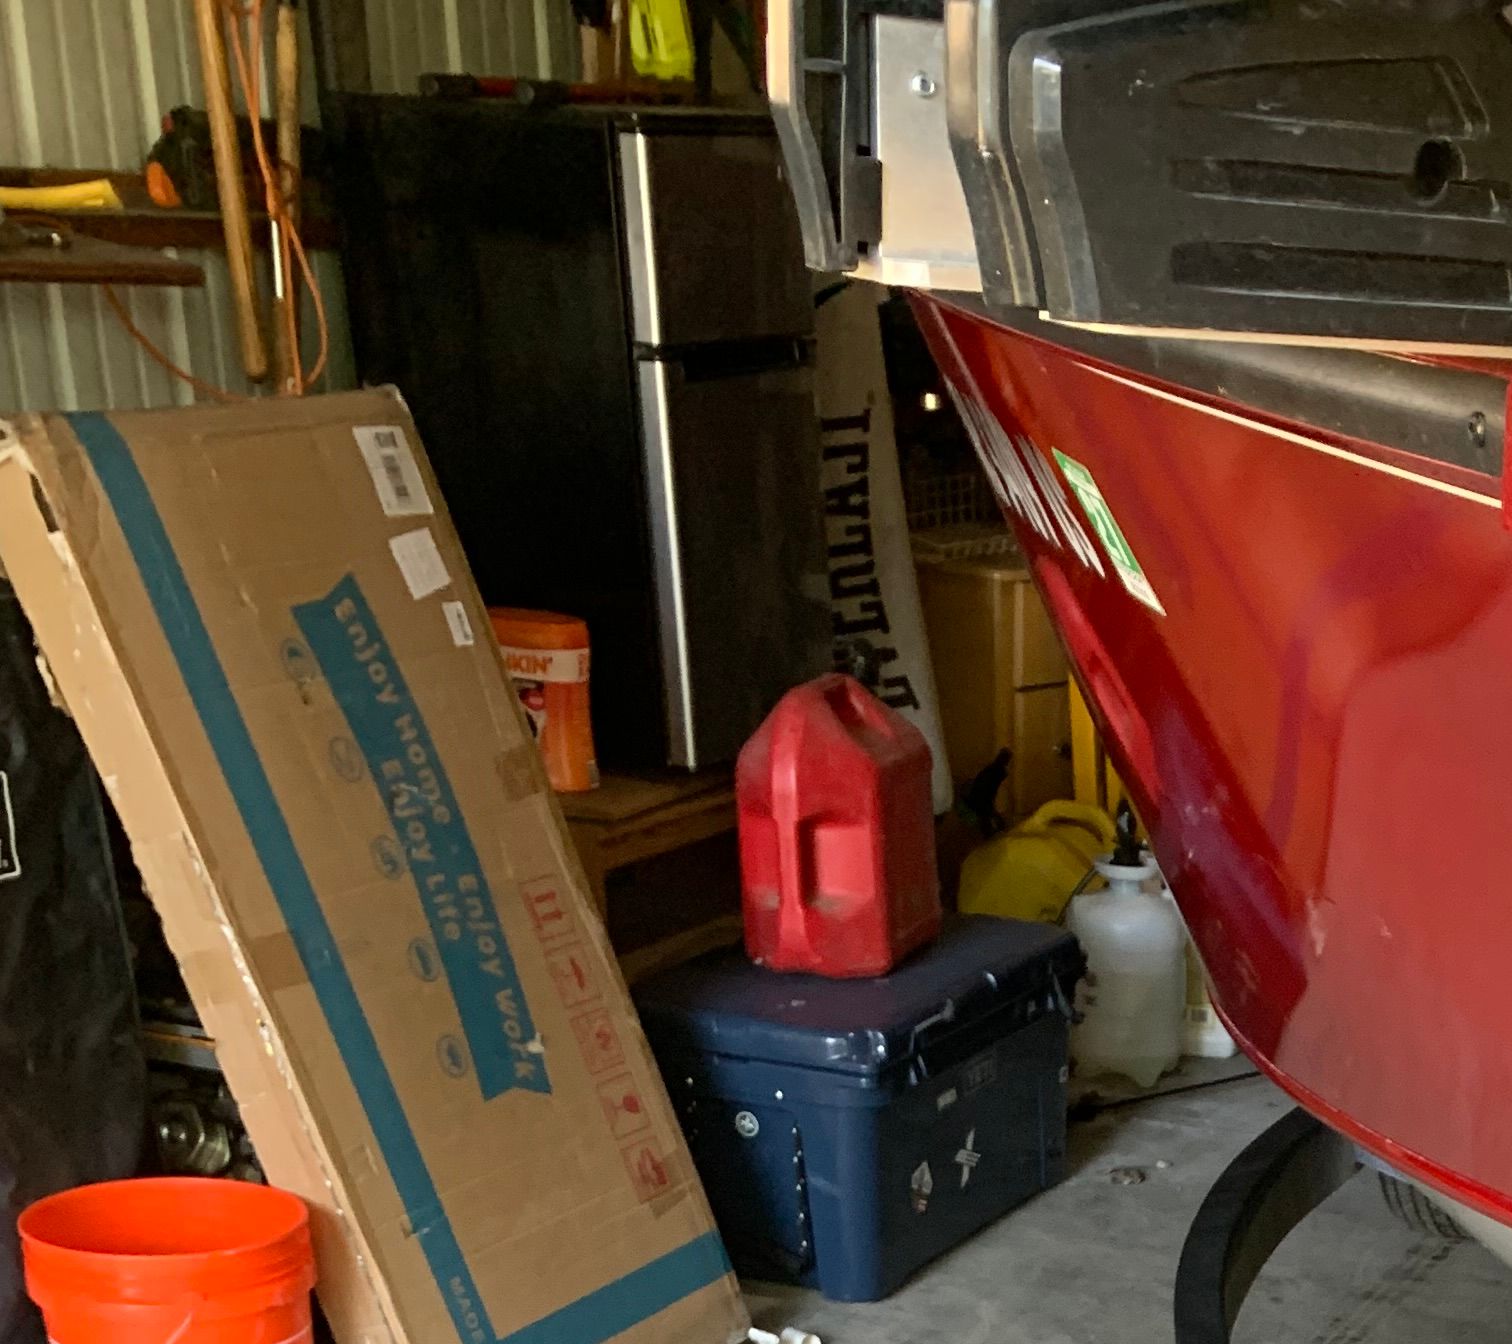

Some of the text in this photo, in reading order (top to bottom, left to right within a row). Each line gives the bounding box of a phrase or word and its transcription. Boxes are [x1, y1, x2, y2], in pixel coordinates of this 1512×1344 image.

[334, 597, 399, 706] Enjoy
[394, 715, 450, 825] Home
[458, 873, 505, 979] Enjoy
[381, 758, 461, 943] Enjoy Life
